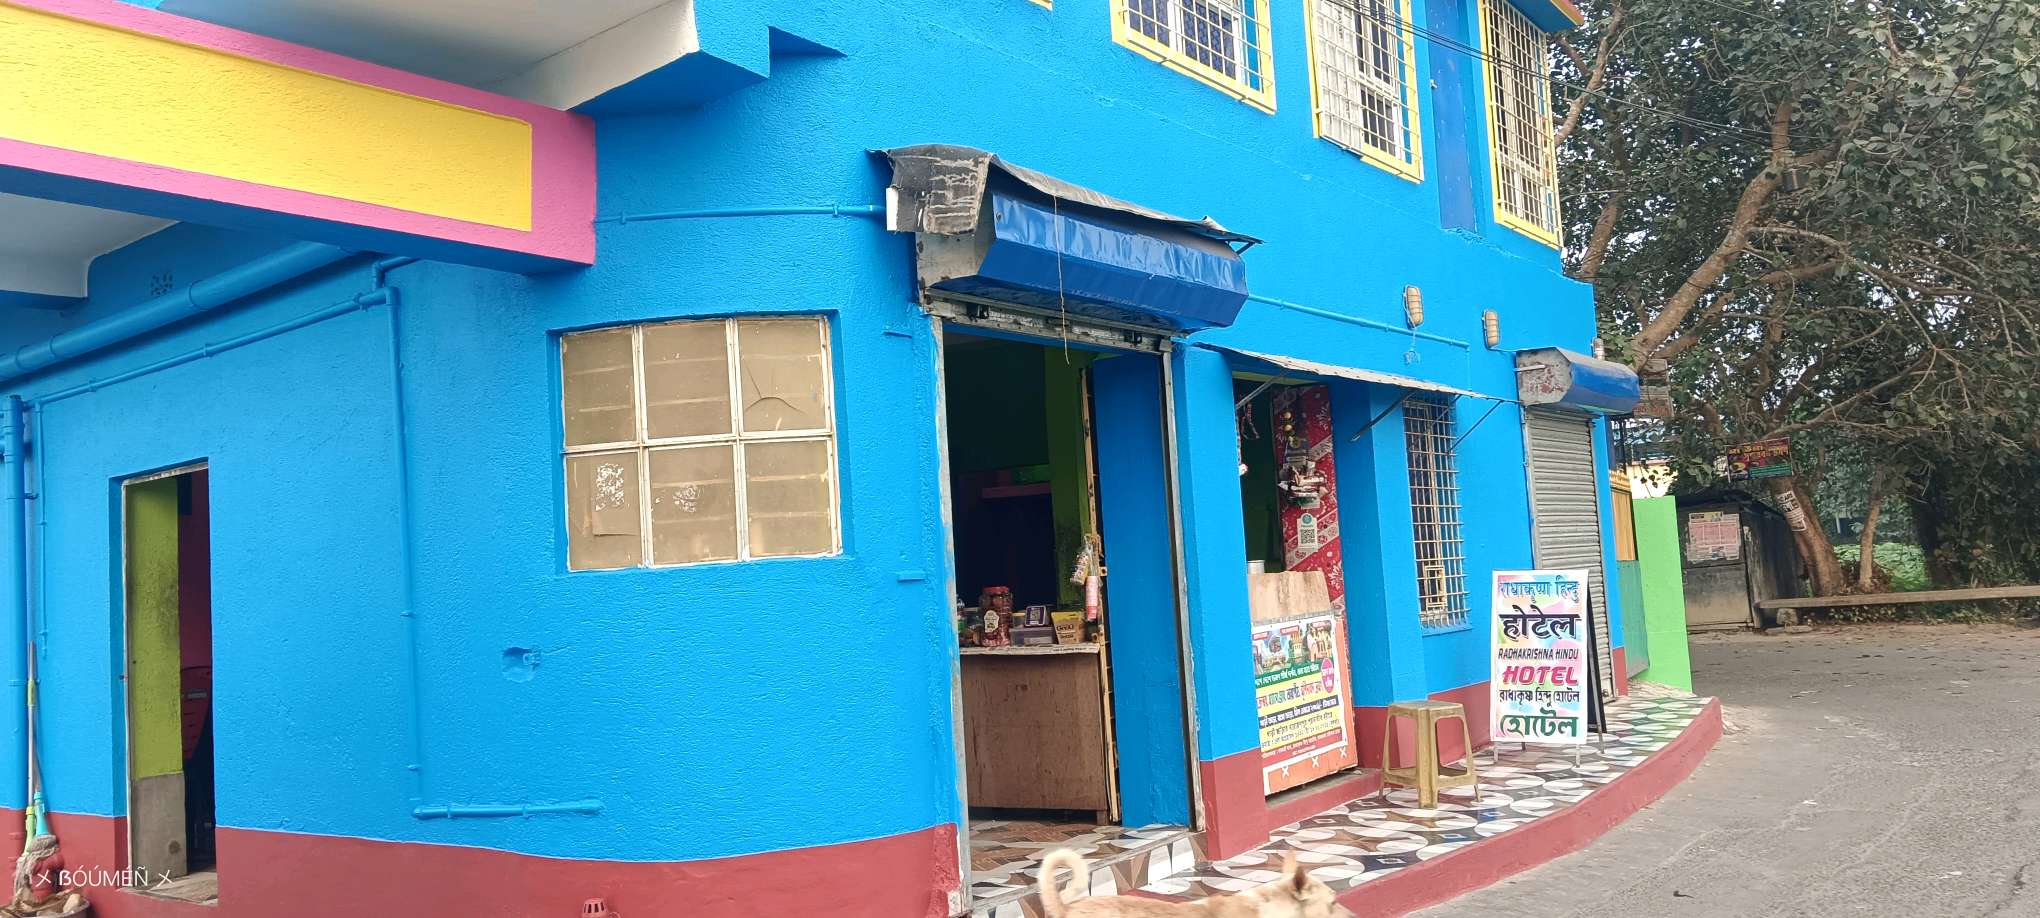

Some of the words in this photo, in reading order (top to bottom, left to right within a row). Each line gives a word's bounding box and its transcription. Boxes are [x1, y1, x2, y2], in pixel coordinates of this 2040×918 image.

[1498, 604, 1582, 642] होटेल
[1498, 648, 1554, 660] RADHAKRISHNA
[1555, 648, 1579, 660] HINDU
[1502, 666, 1579, 686] HOTEL
[1553, 686, 1580, 703] হোটেল
[1499, 707, 1580, 738] হোটেল
